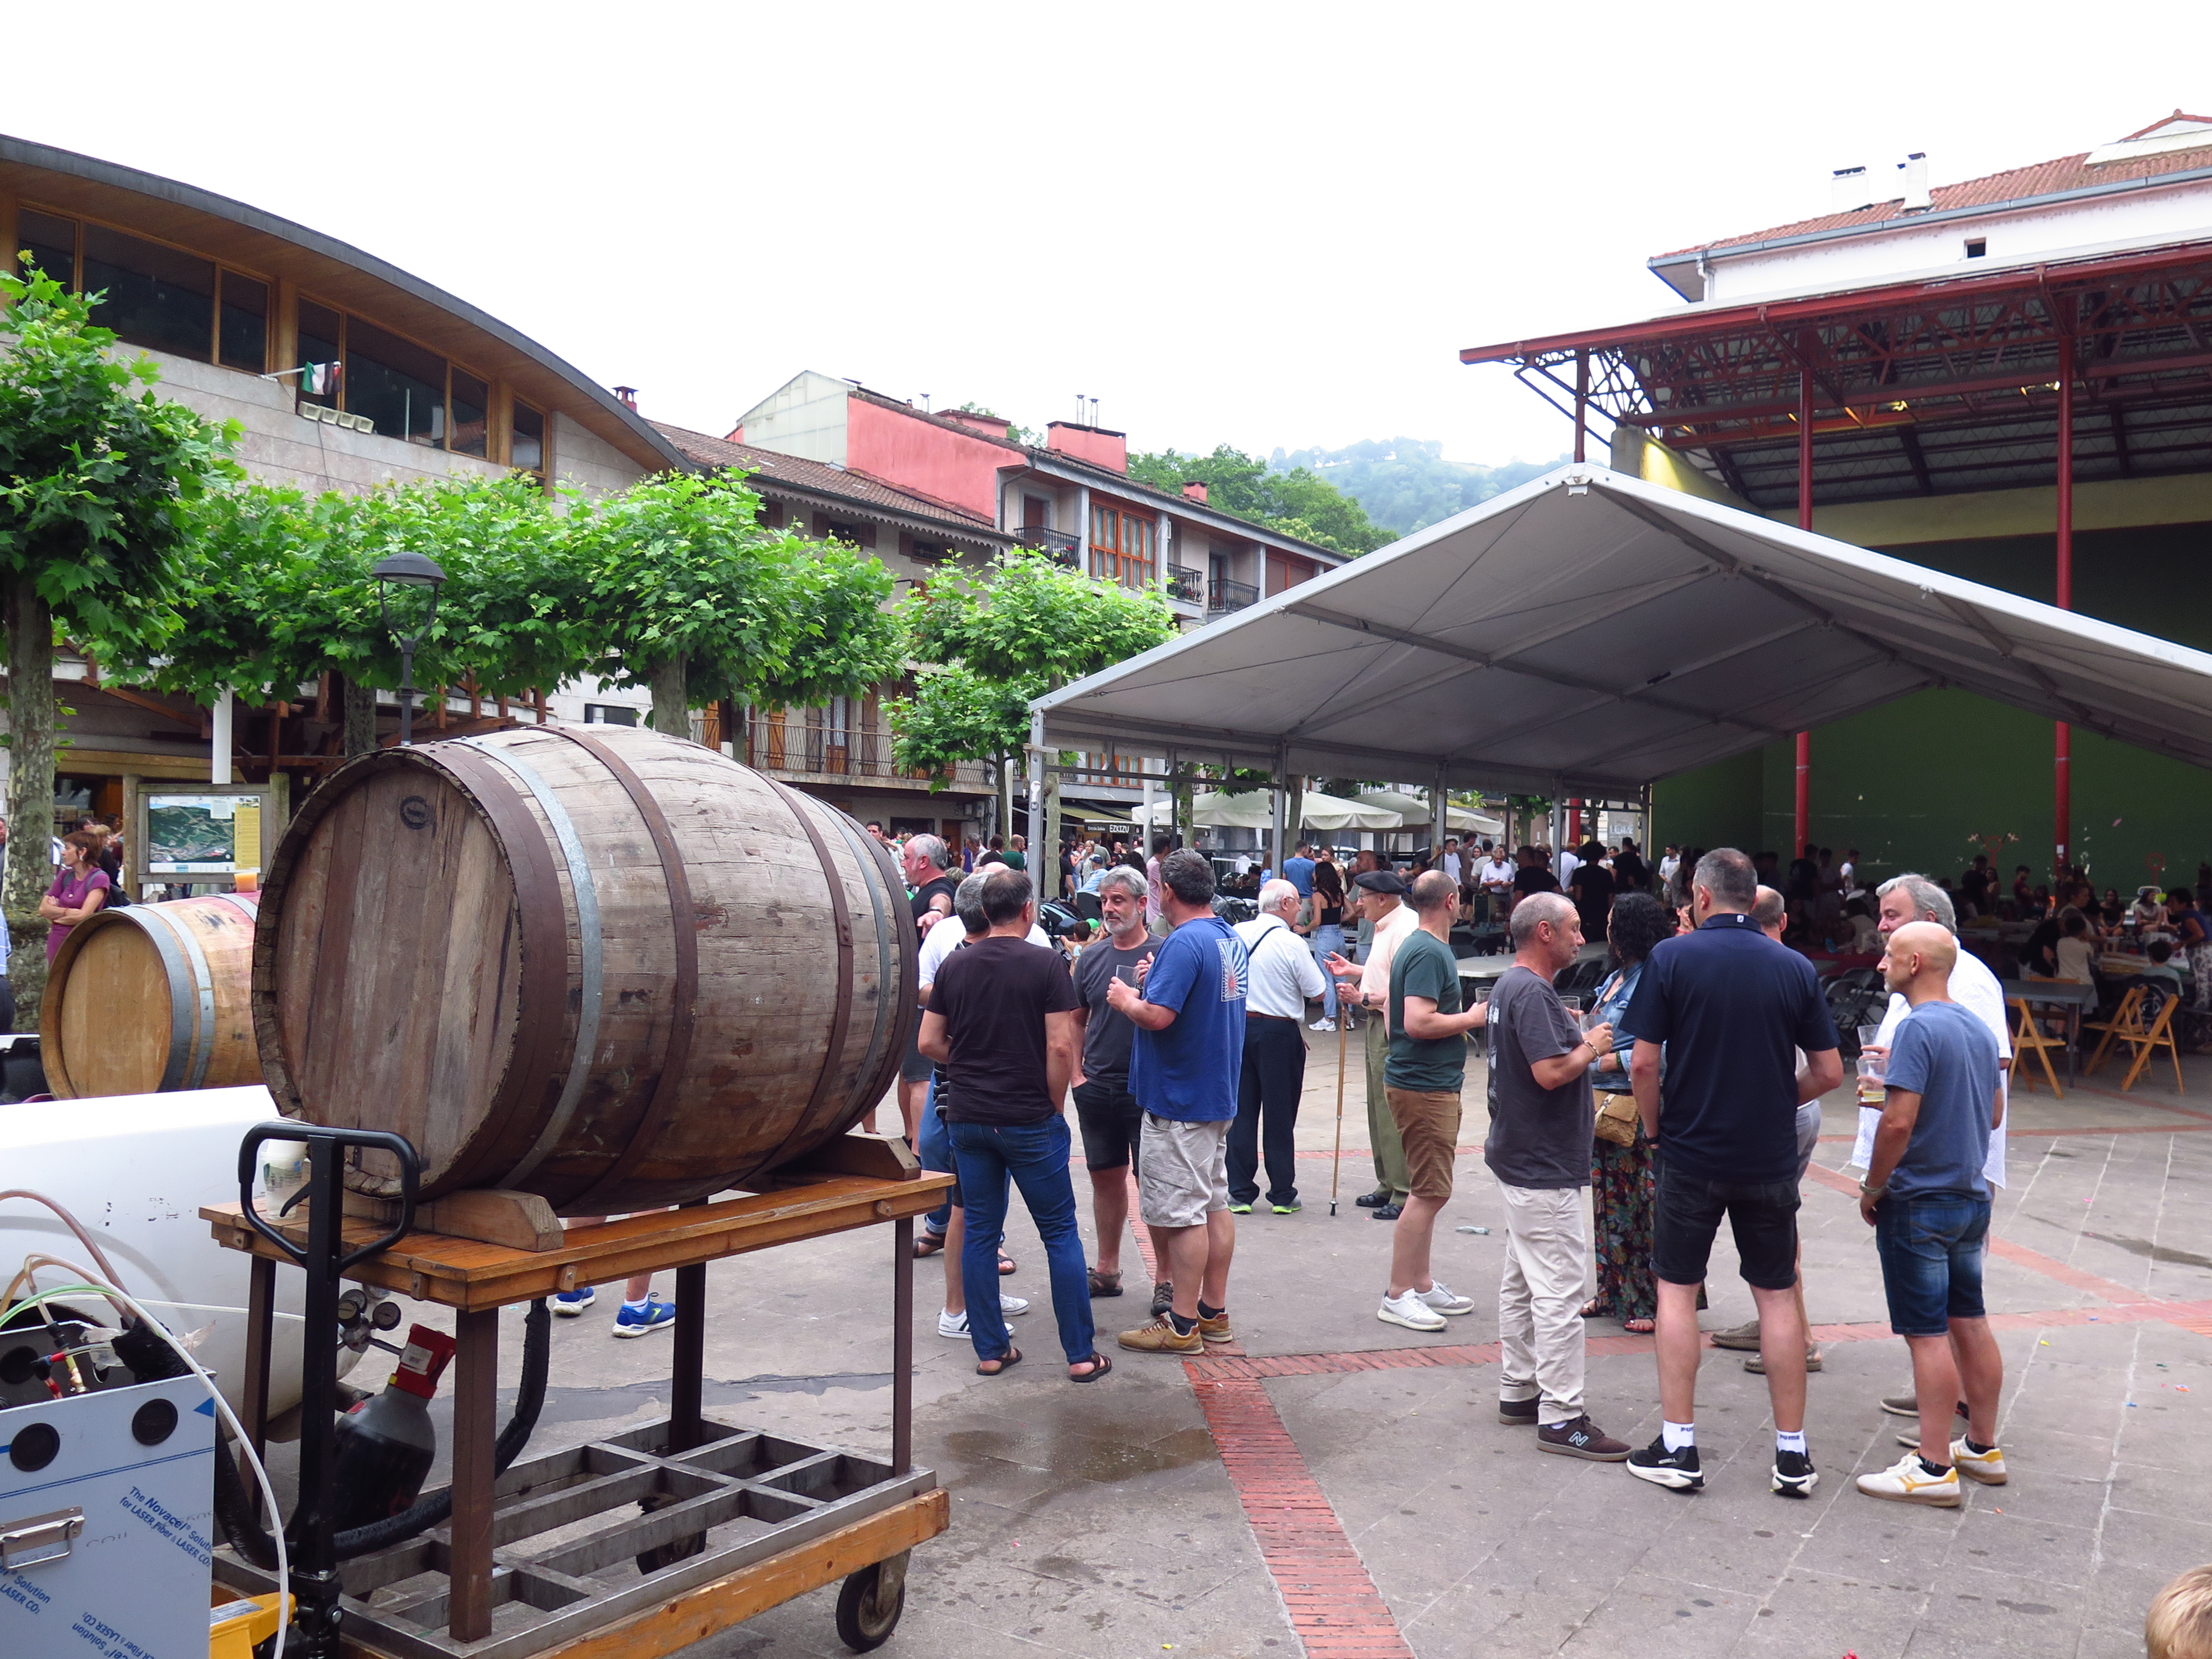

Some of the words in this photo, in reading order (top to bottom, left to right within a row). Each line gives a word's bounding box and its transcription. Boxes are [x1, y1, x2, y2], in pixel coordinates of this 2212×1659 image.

[1109, 824, 1130, 833] EZKIZU
[1568, 1431, 1589, 1447] N
[129, 1485, 145, 1503] The
[119, 1496, 132, 1509] for
[131, 1505, 155, 1526] LASER
[153, 1521, 173, 1538] Fiber
[176, 1537, 200, 1558] LASER
[0, 1583, 27, 1604] LASER
[14, 1575, 51, 1604] Solution
[72, 1623, 107, 1650] Solution
[95, 1621, 121, 1642] LASER
[123, 1641, 144, 1658] Fiber
